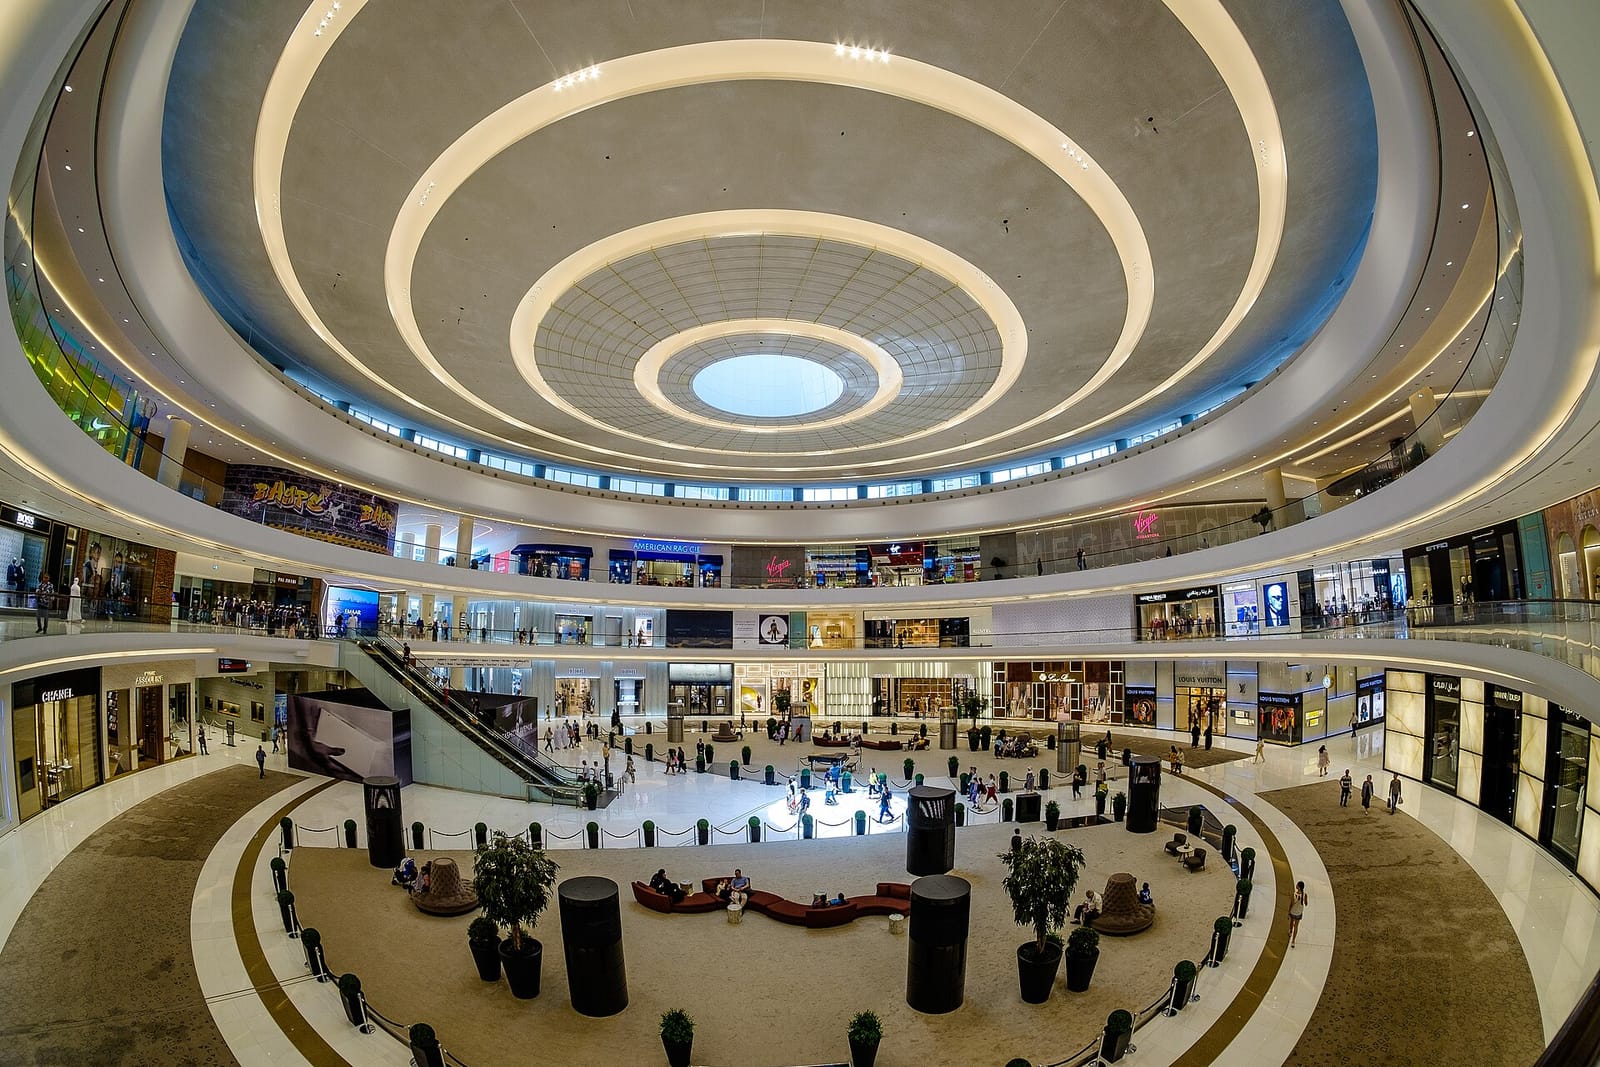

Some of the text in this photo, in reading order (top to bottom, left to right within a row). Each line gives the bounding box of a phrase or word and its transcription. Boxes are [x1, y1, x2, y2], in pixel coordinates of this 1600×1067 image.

[17, 512, 35, 526] BOSS
[1134, 511, 1159, 533] Virgin
[633, 542, 672, 551] AMERICAN
[1426, 542, 1448, 552] ETRO
[766, 555, 791, 577] Virgin
[42, 688, 74, 702] CHANEL
